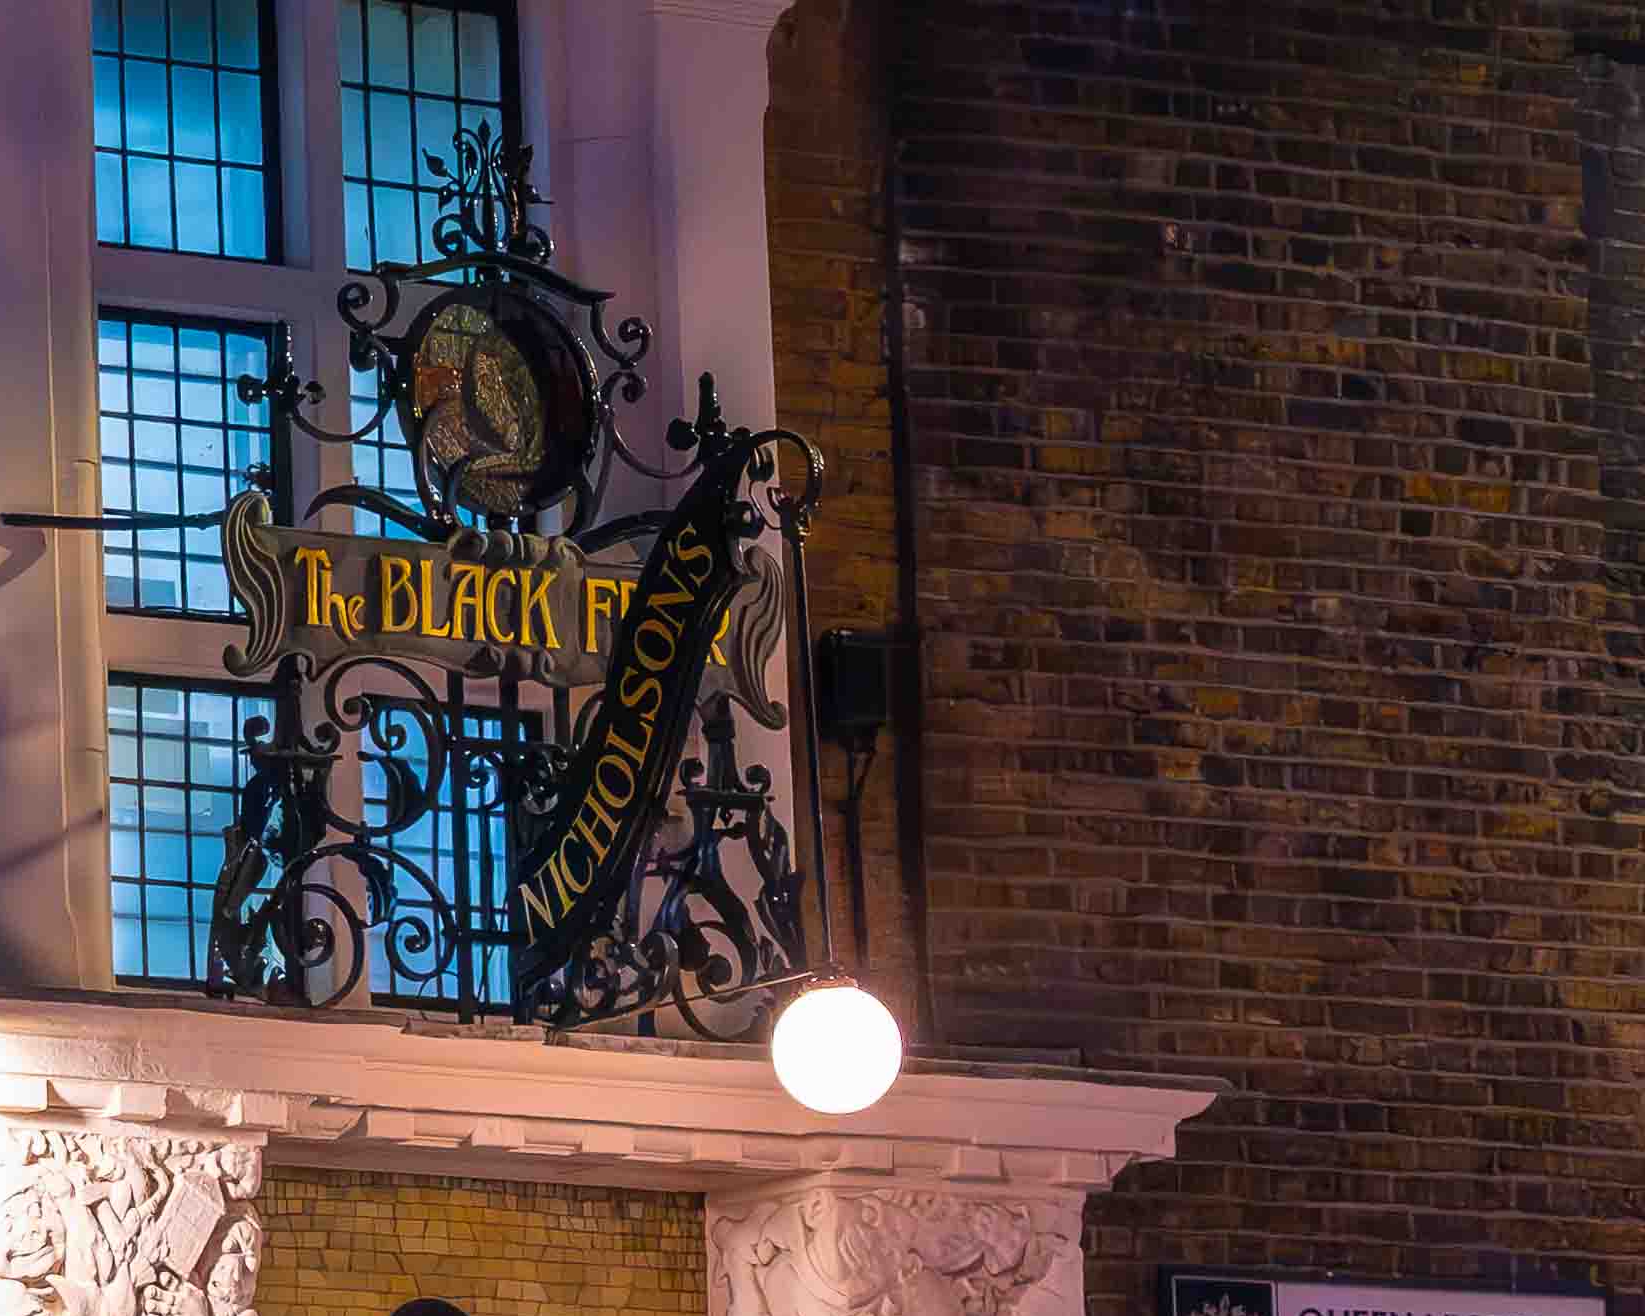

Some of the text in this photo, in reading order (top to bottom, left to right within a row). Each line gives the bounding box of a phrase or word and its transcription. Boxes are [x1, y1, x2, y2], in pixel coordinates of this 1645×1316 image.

[294, 545, 366, 638] The
[381, 555, 561, 650] BLACK
[517, 522, 714, 947] NICHOLSON'S
